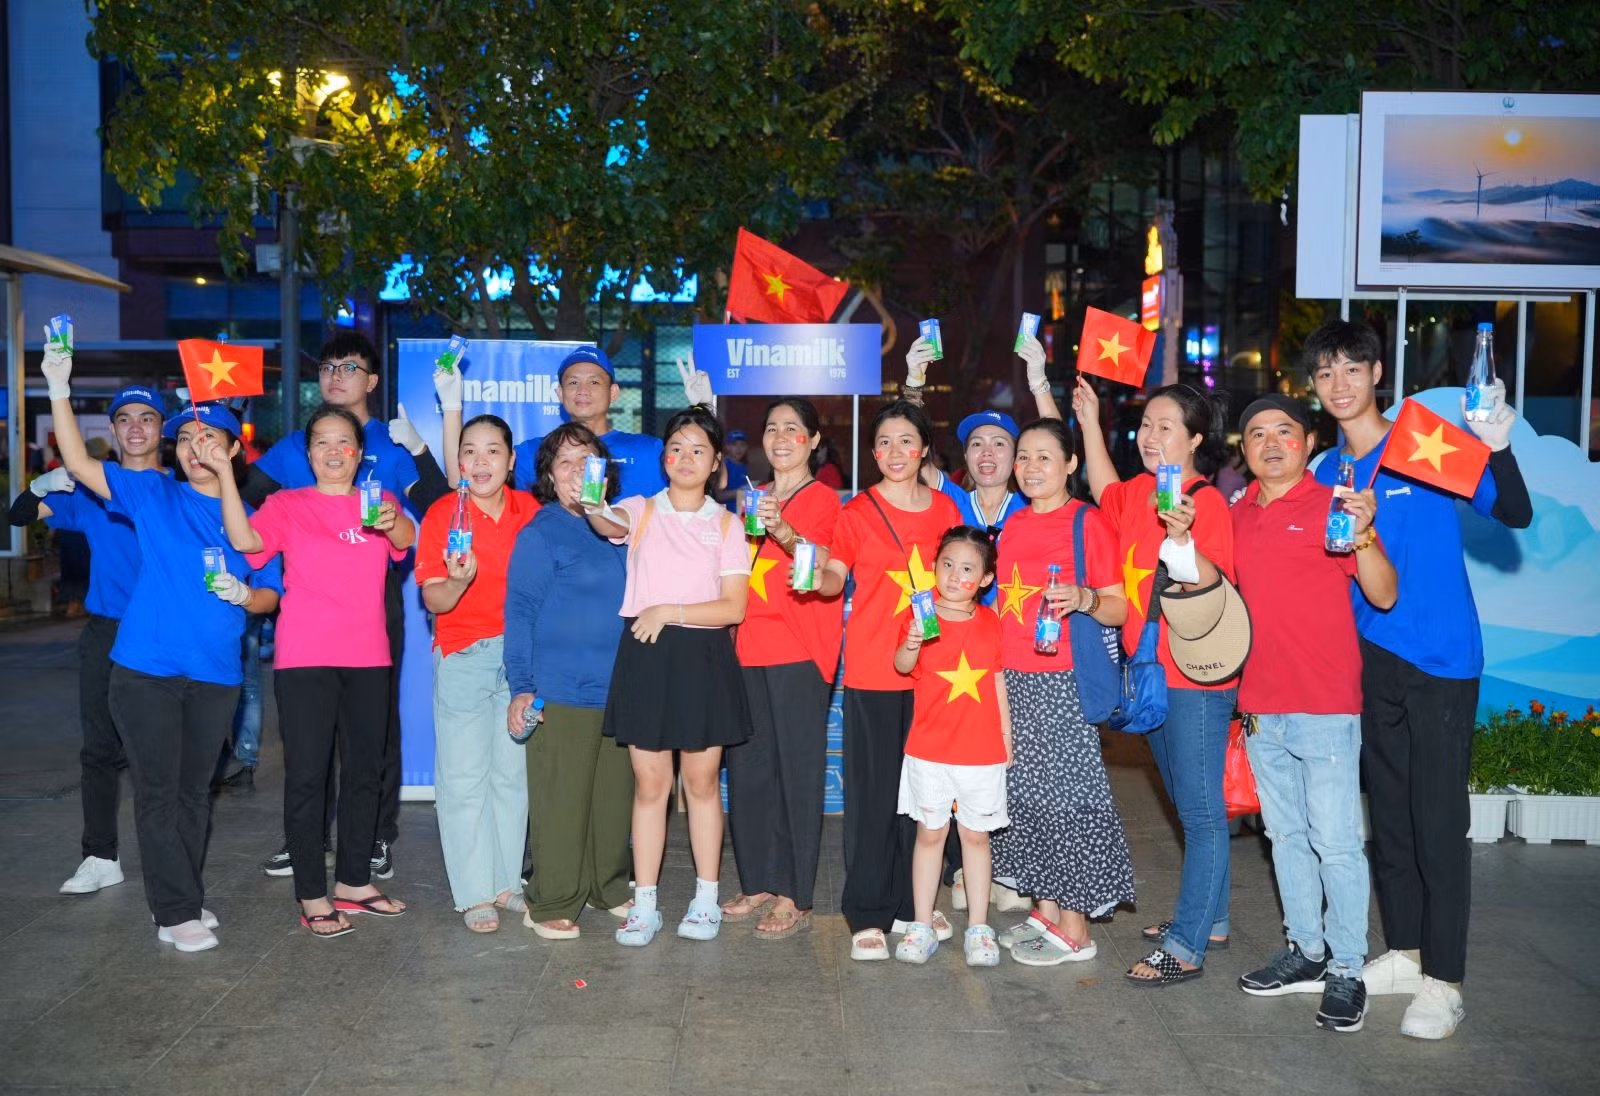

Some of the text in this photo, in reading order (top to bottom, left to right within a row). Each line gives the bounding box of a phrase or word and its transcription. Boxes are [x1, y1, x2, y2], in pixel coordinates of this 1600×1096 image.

[726, 338, 846, 366] Vinamilk
[727, 368, 846, 378] EST 1976
[463, 374, 561, 402] namilk
[1186, 662, 1225, 671] CHANEL
